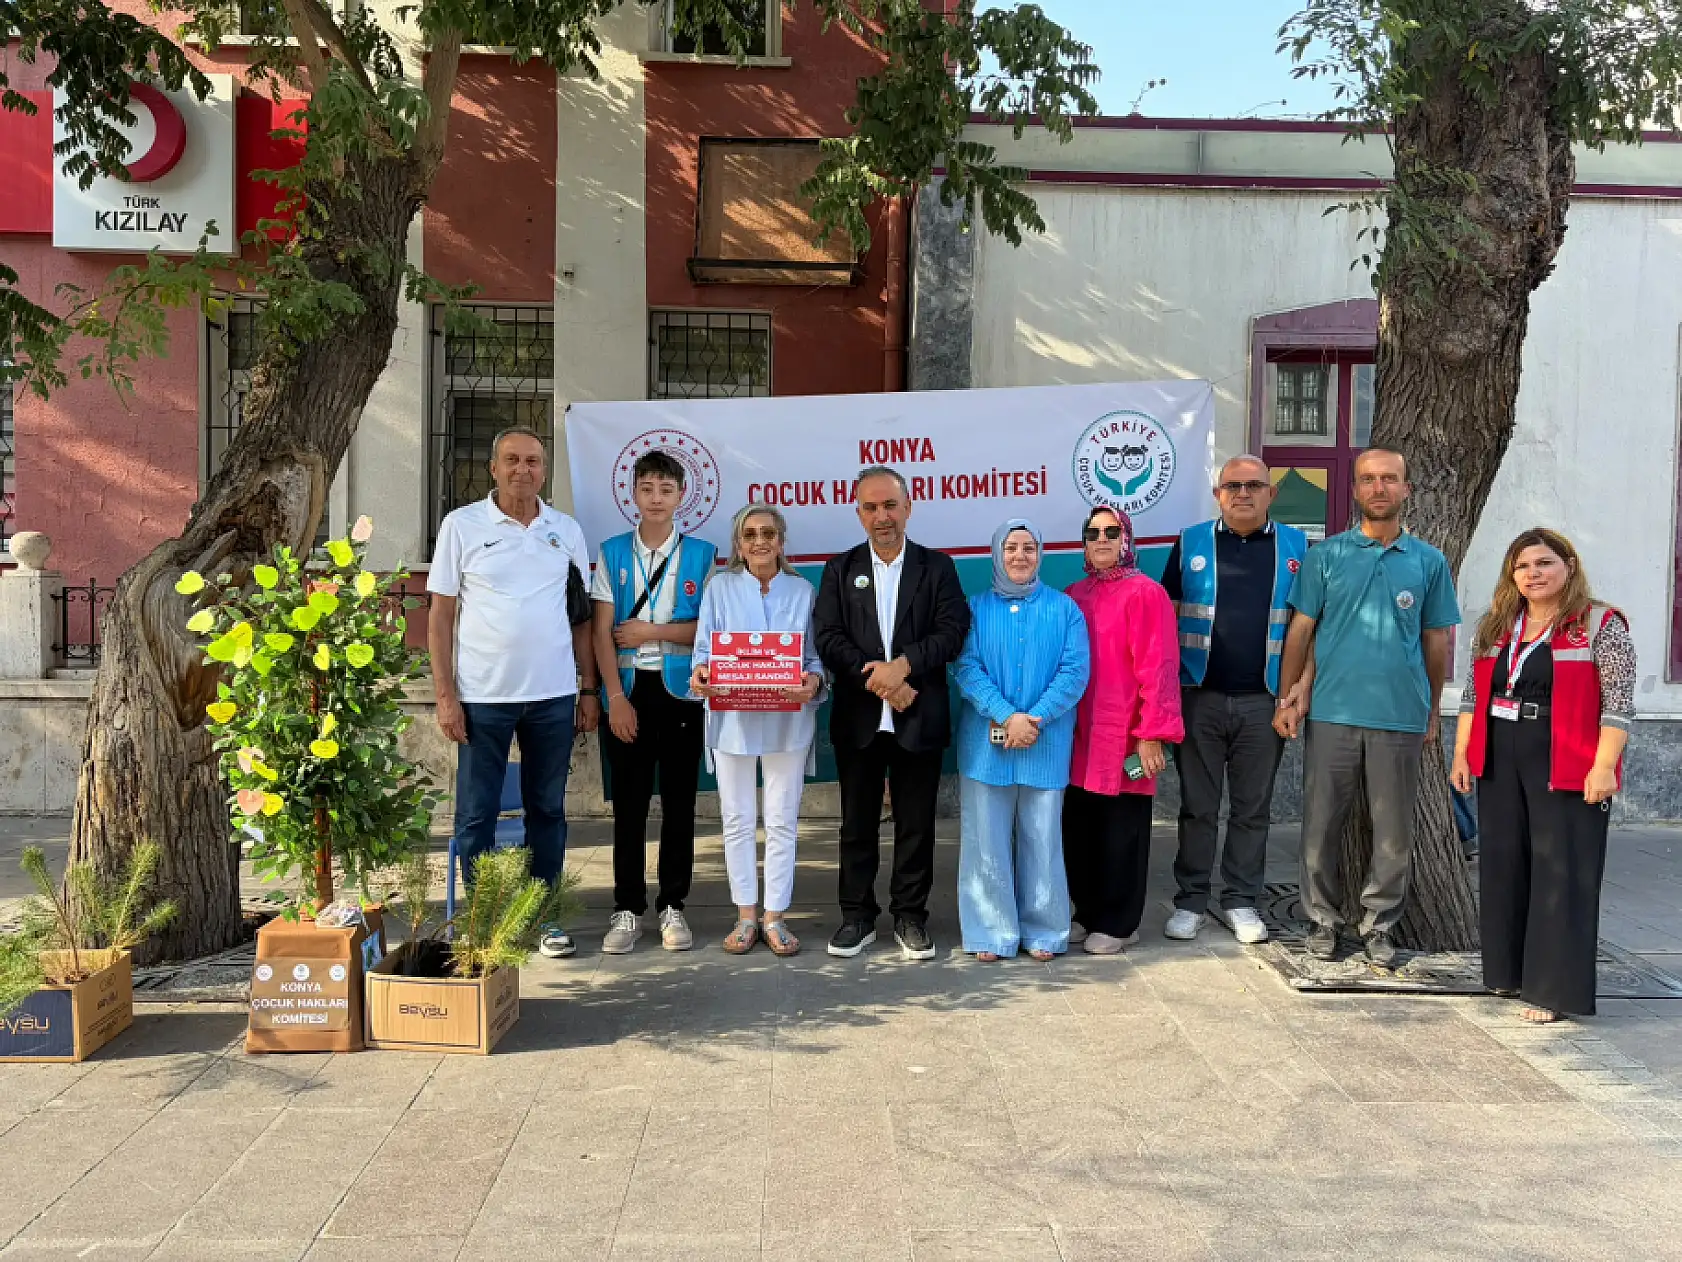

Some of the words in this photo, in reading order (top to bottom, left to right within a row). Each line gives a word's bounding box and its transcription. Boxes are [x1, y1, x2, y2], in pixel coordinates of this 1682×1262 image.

[123, 194, 161, 209] TÜRK
[95, 210, 189, 233] KIZILAY
[1090, 419, 1157, 444] TÜRKİYE
[859, 437, 936, 465] KONYA
[941, 464, 1047, 500] KOMİTESİ
[280, 981, 322, 993] KONYA
[251, 998, 294, 1010] ÇOCUK
[297, 998, 348, 1009] HAKLARI
[271, 1011, 328, 1024] KOMİTESİ
